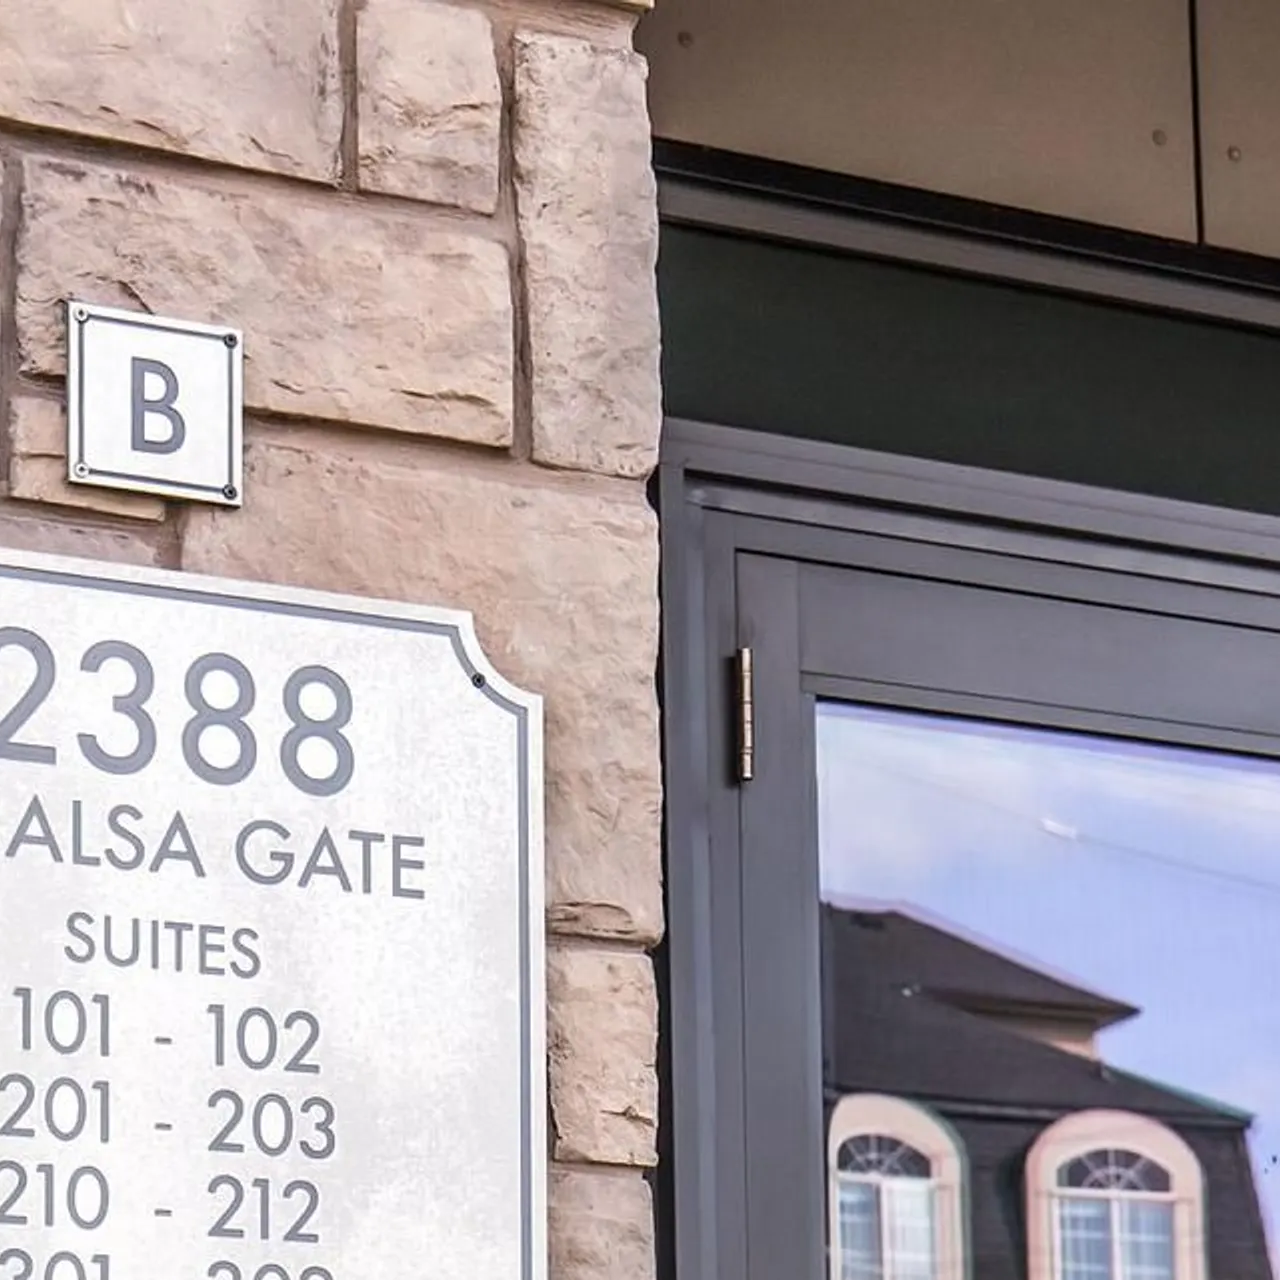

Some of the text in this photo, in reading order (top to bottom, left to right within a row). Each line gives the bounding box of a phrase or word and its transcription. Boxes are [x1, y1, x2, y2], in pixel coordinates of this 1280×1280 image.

[130, 355, 186, 455] B
[235, 819, 426, 901] GATE
[64, 911, 261, 979] SUITES
[12, 986, 110, 1057] 101
[206, 1003, 321, 1075] 102
[207, 1088, 336, 1160] 203
[207, 1174, 320, 1244] 212
